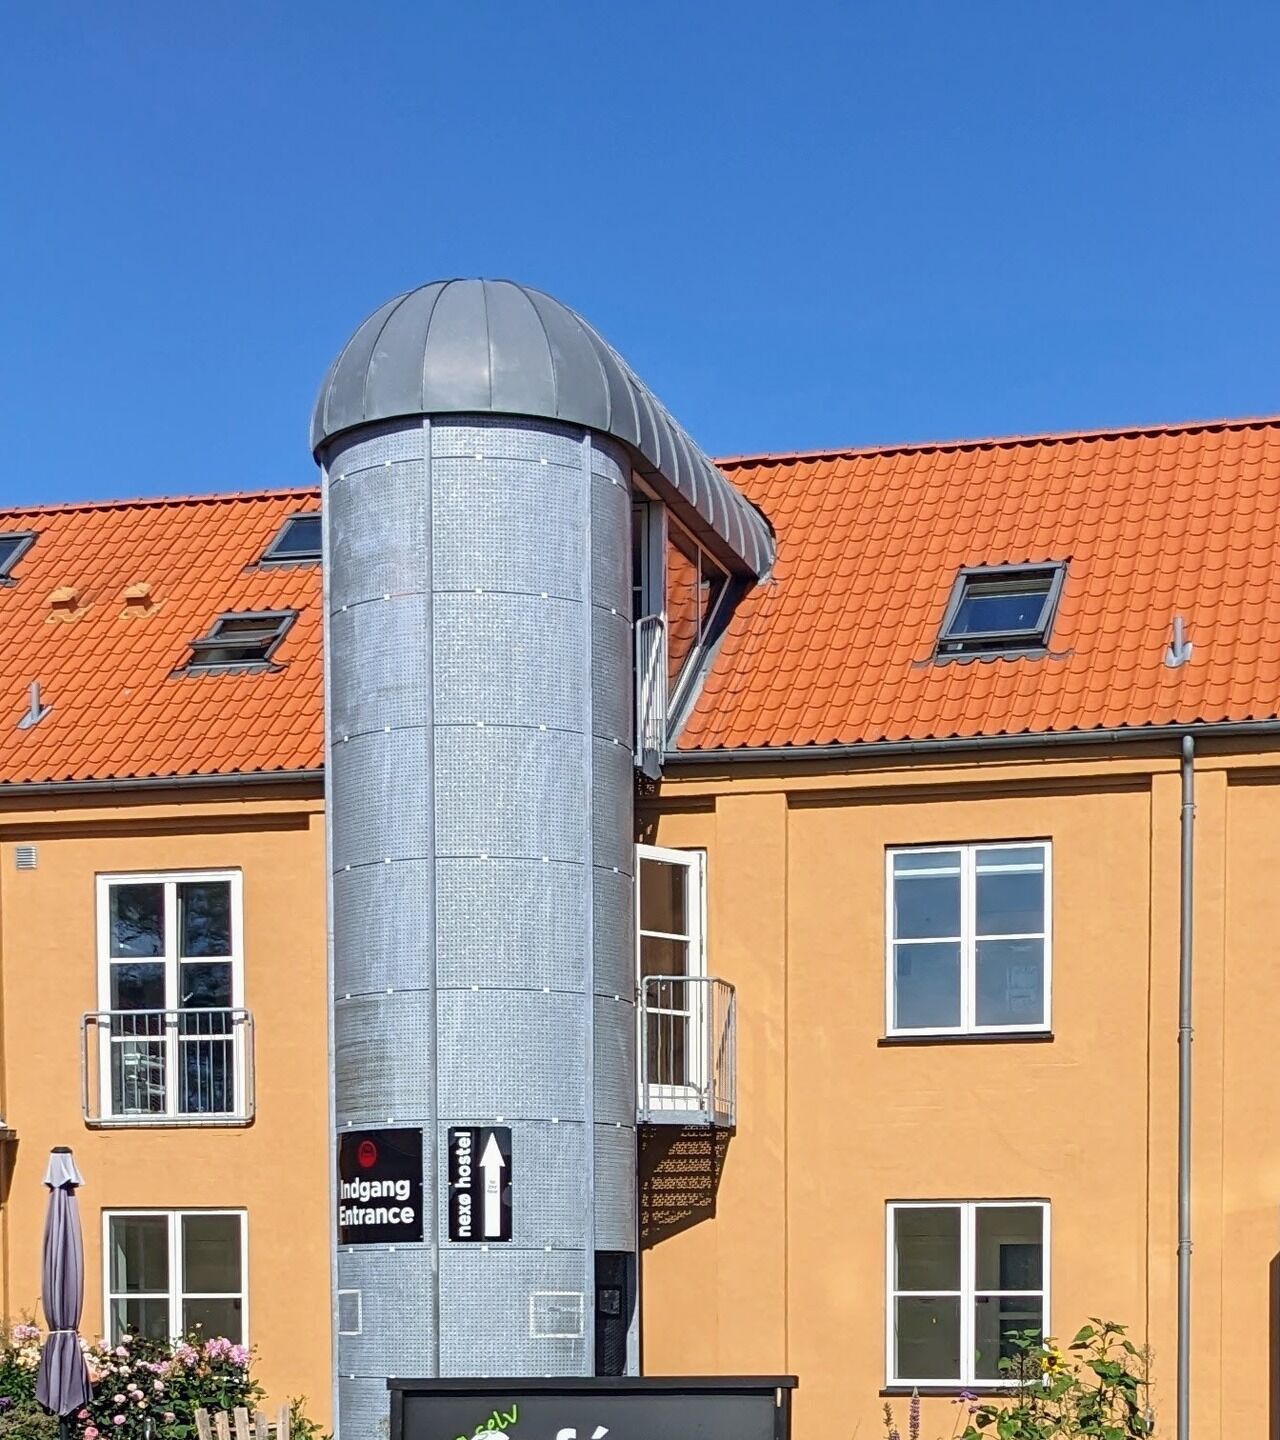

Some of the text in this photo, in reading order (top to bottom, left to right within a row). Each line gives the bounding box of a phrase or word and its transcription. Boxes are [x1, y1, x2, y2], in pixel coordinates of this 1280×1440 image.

[454, 1131, 472, 1188] hostel
[339, 1177, 411, 1203] Indgang
[338, 1205, 415, 1226] Entrance
